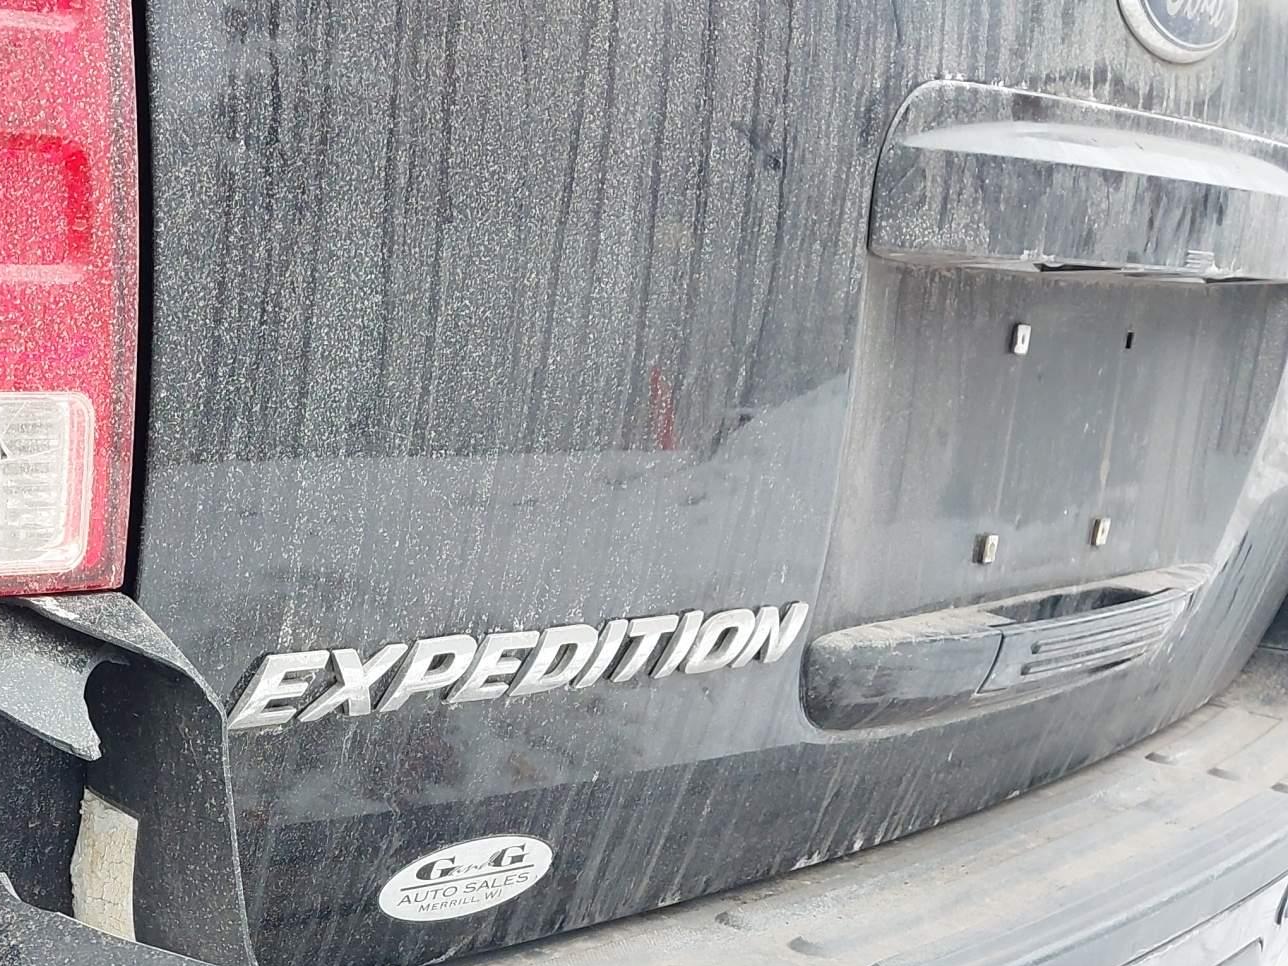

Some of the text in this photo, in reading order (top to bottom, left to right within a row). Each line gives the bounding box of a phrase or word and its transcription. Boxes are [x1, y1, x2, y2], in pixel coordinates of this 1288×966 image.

[227, 601, 809, 730] EXPEDITION
[397, 872, 529, 907] AUTO SALES
[484, 888, 503, 901] WI
